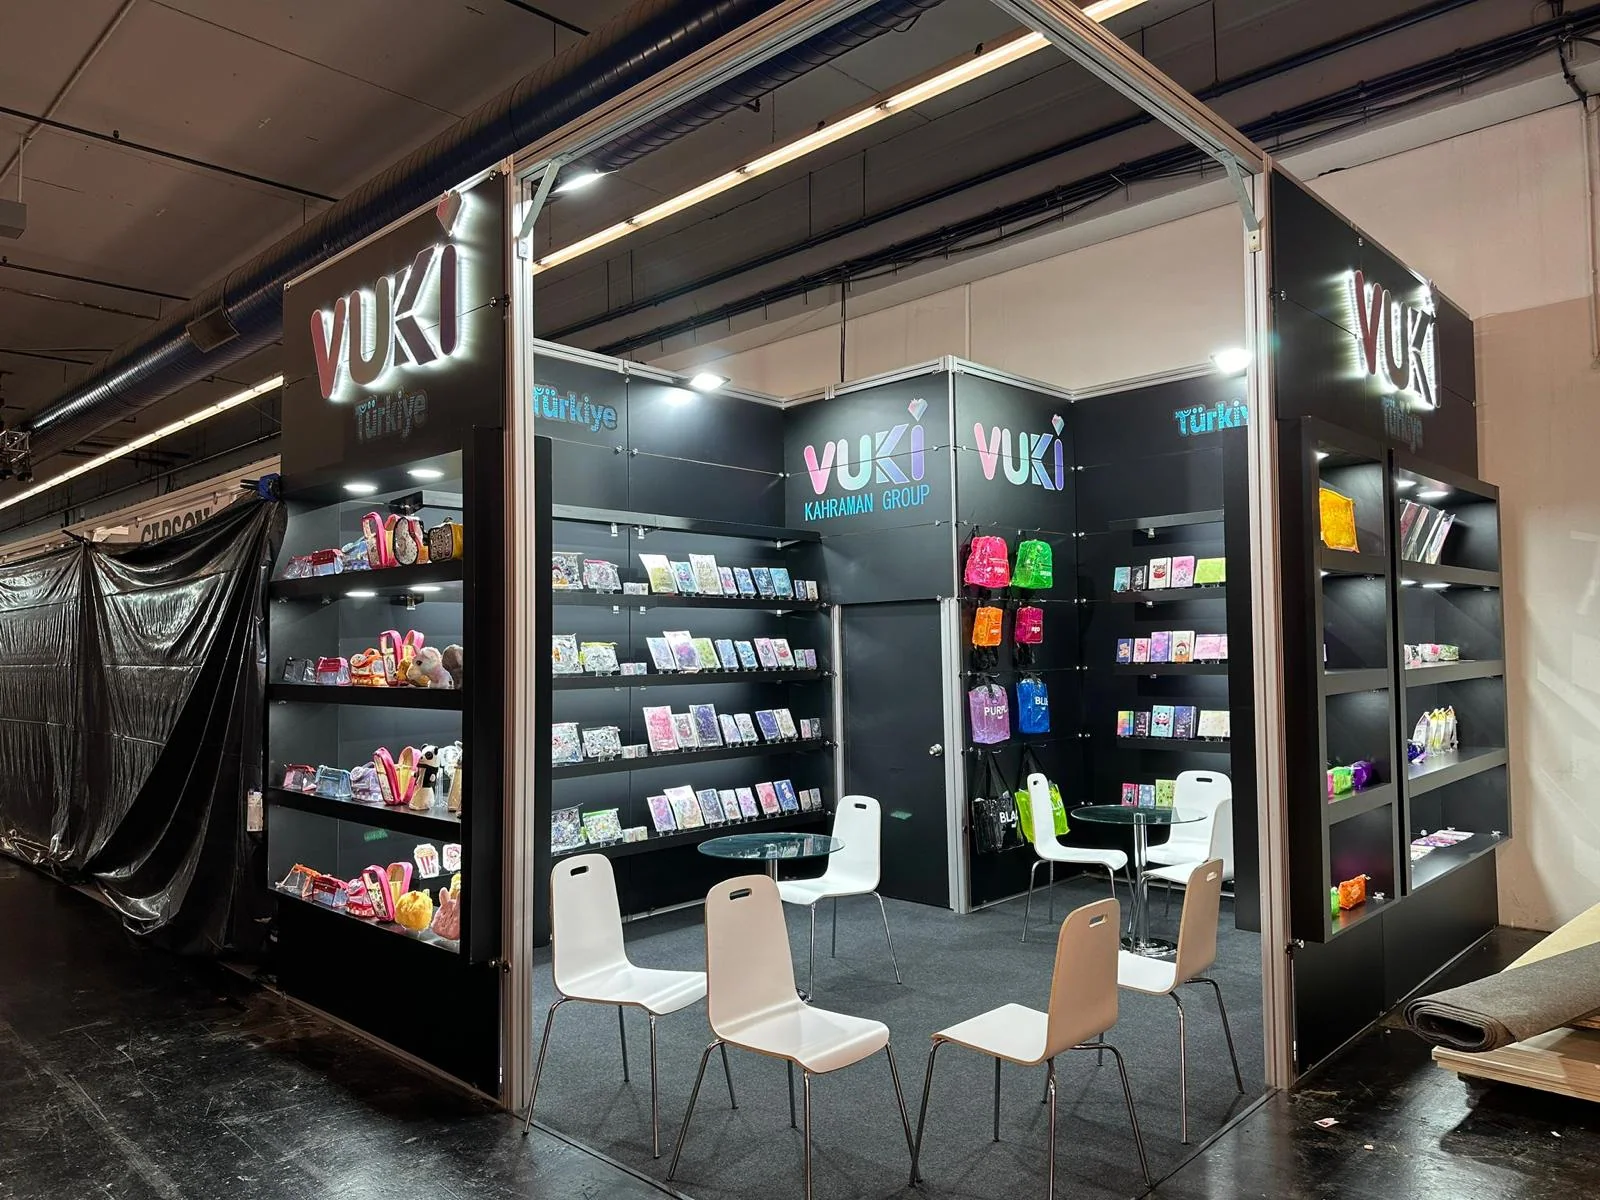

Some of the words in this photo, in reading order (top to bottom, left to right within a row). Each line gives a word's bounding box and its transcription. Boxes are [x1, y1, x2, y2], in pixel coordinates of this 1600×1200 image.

[355, 389, 427, 443] Türkiye
[534, 386, 618, 432] Türkiye
[1175, 400, 1248, 434] Türki
[804, 493, 873, 521] KAHRAMAN
[882, 484, 930, 510] GROUP
[1000, 810, 1018, 823] BLA
